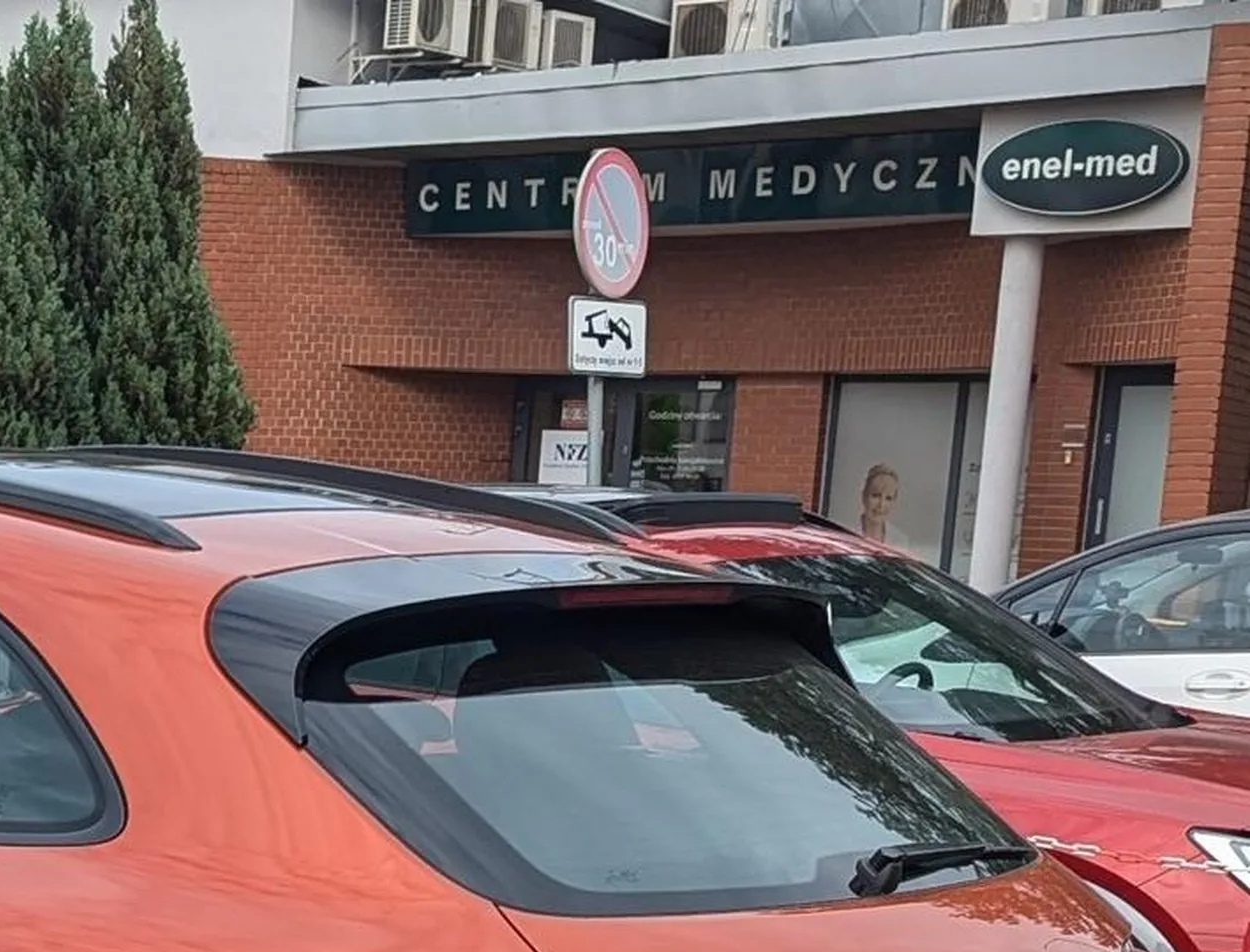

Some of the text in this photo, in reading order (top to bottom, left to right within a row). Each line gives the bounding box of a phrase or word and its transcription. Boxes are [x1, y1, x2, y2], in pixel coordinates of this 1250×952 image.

[1002, 144, 1159, 181] enel-med
[418, 172, 666, 213] CENTRM
[554, 443, 588, 461] NFZ
